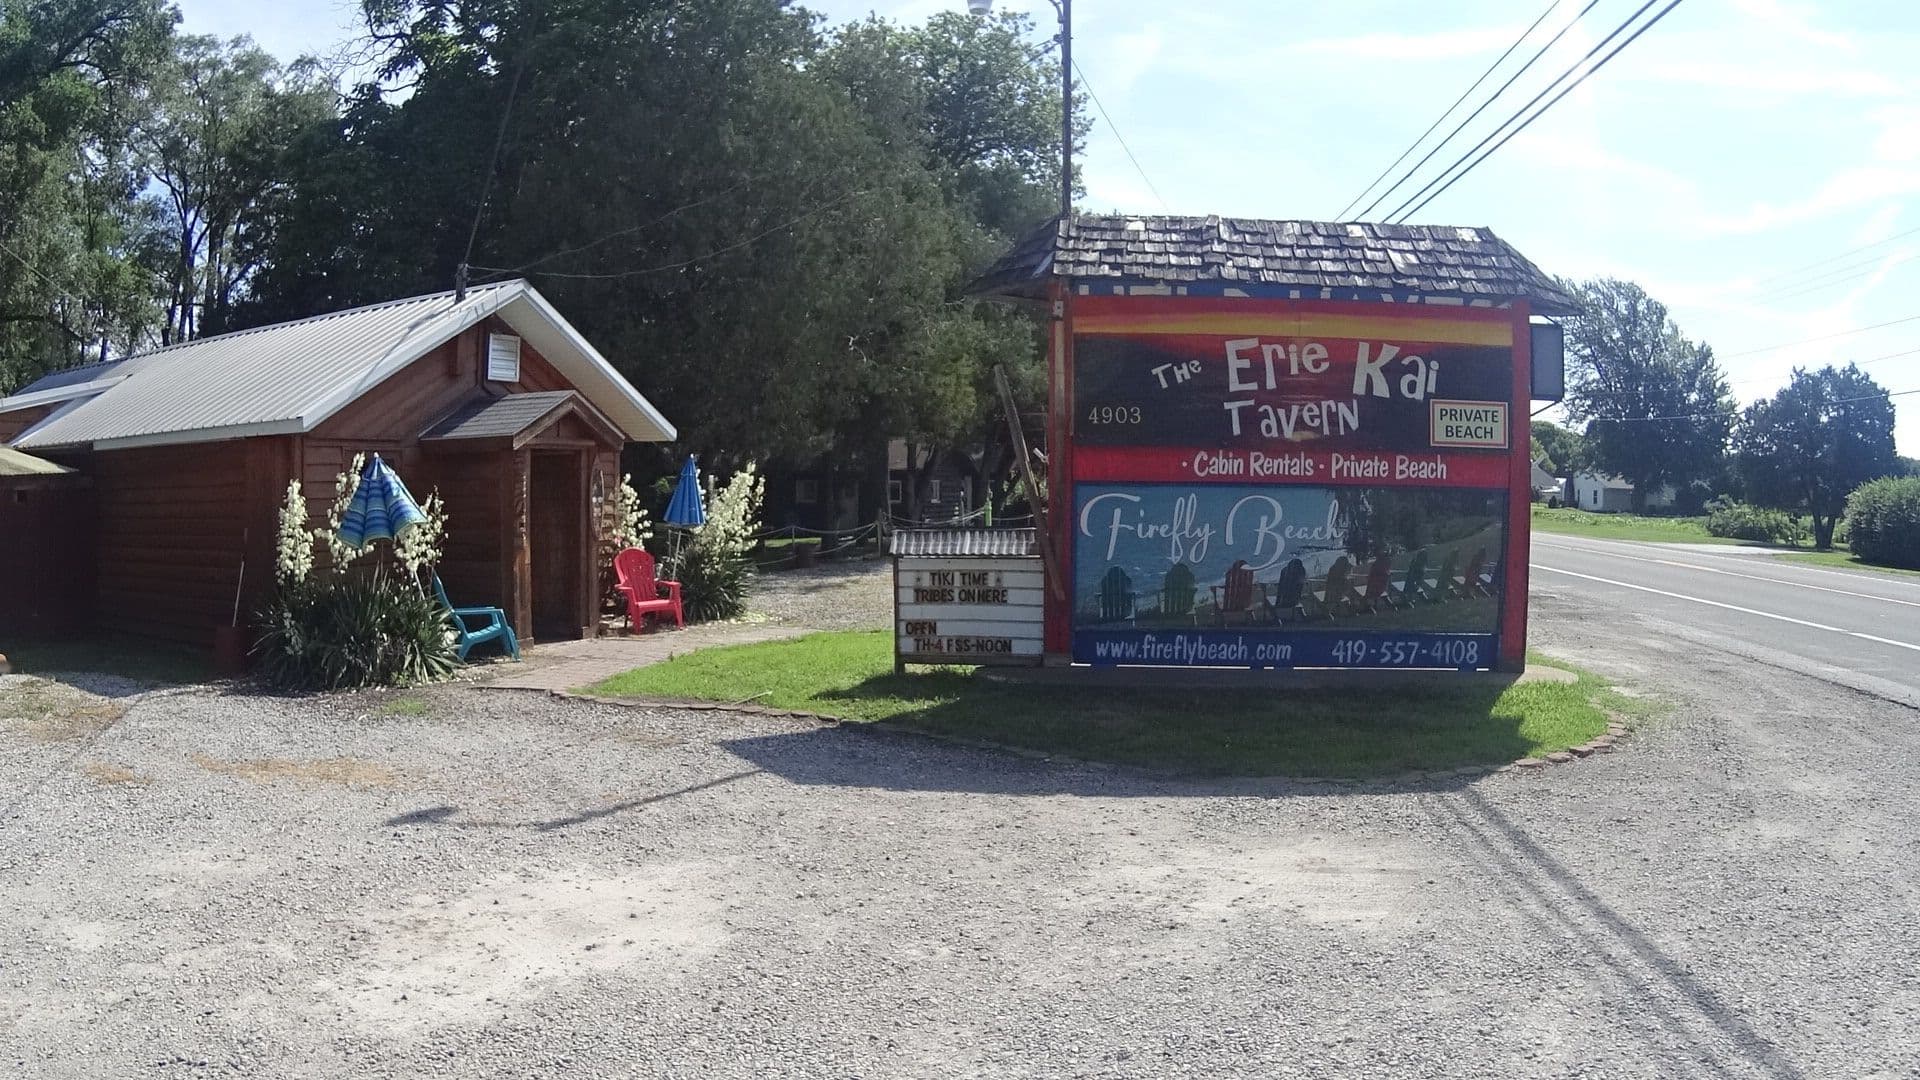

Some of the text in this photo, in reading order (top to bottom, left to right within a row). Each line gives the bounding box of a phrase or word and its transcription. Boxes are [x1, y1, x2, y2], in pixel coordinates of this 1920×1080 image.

[1224, 337, 1330, 393] Erie
[1352, 341, 1440, 400] Kai
[1088, 406, 1142, 425] 4903
[1439, 408, 1499, 424] PRIVATE
[1445, 424, 1494, 440] BEACH
[1193, 451, 1447, 480] Cabin Rentals Private Beach
[1080, 493, 1344, 572] Firefly Beach
[929, 572, 989, 586] TIKI TIME
[913, 588, 955, 603] TRIBES
[1095, 634, 1479, 666] www.fireflybeach.com 419-557-4108
